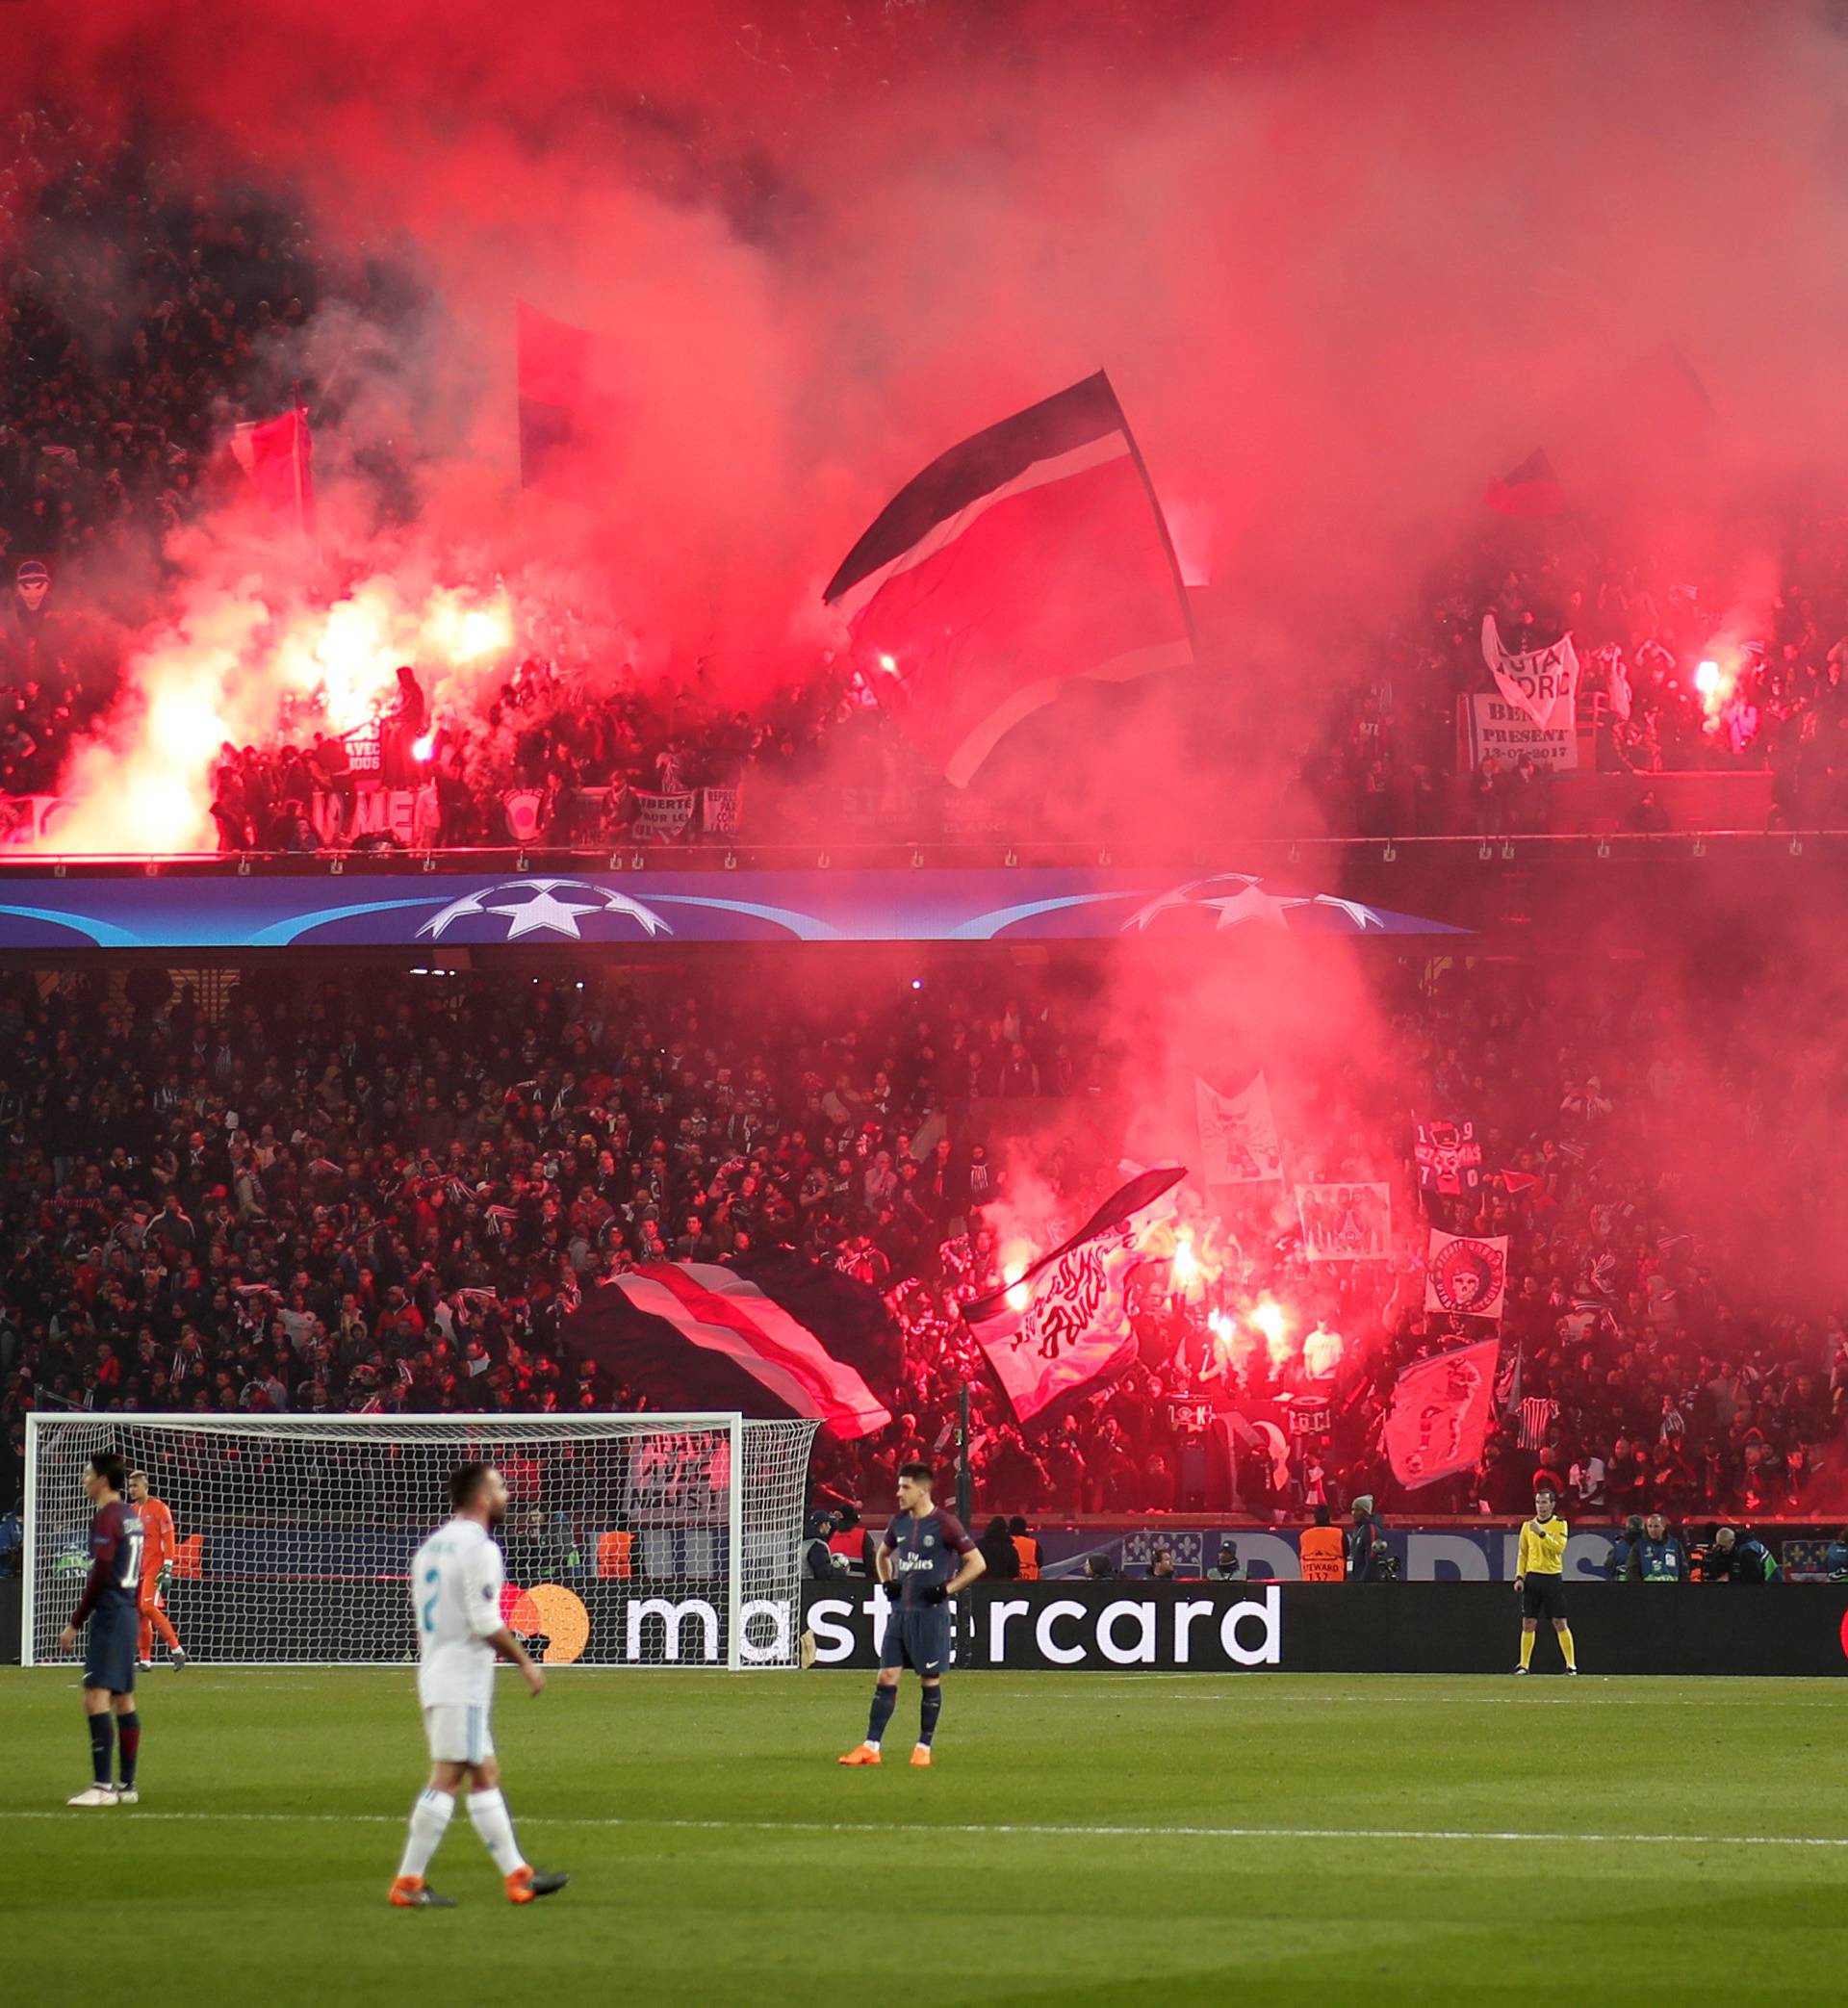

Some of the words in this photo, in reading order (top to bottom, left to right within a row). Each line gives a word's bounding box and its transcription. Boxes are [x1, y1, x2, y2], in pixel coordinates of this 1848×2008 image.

[1483, 728, 1569, 743] PRESENT
[424, 1568, 439, 1633] 2
[626, 1583, 1281, 1664] mastrcard
